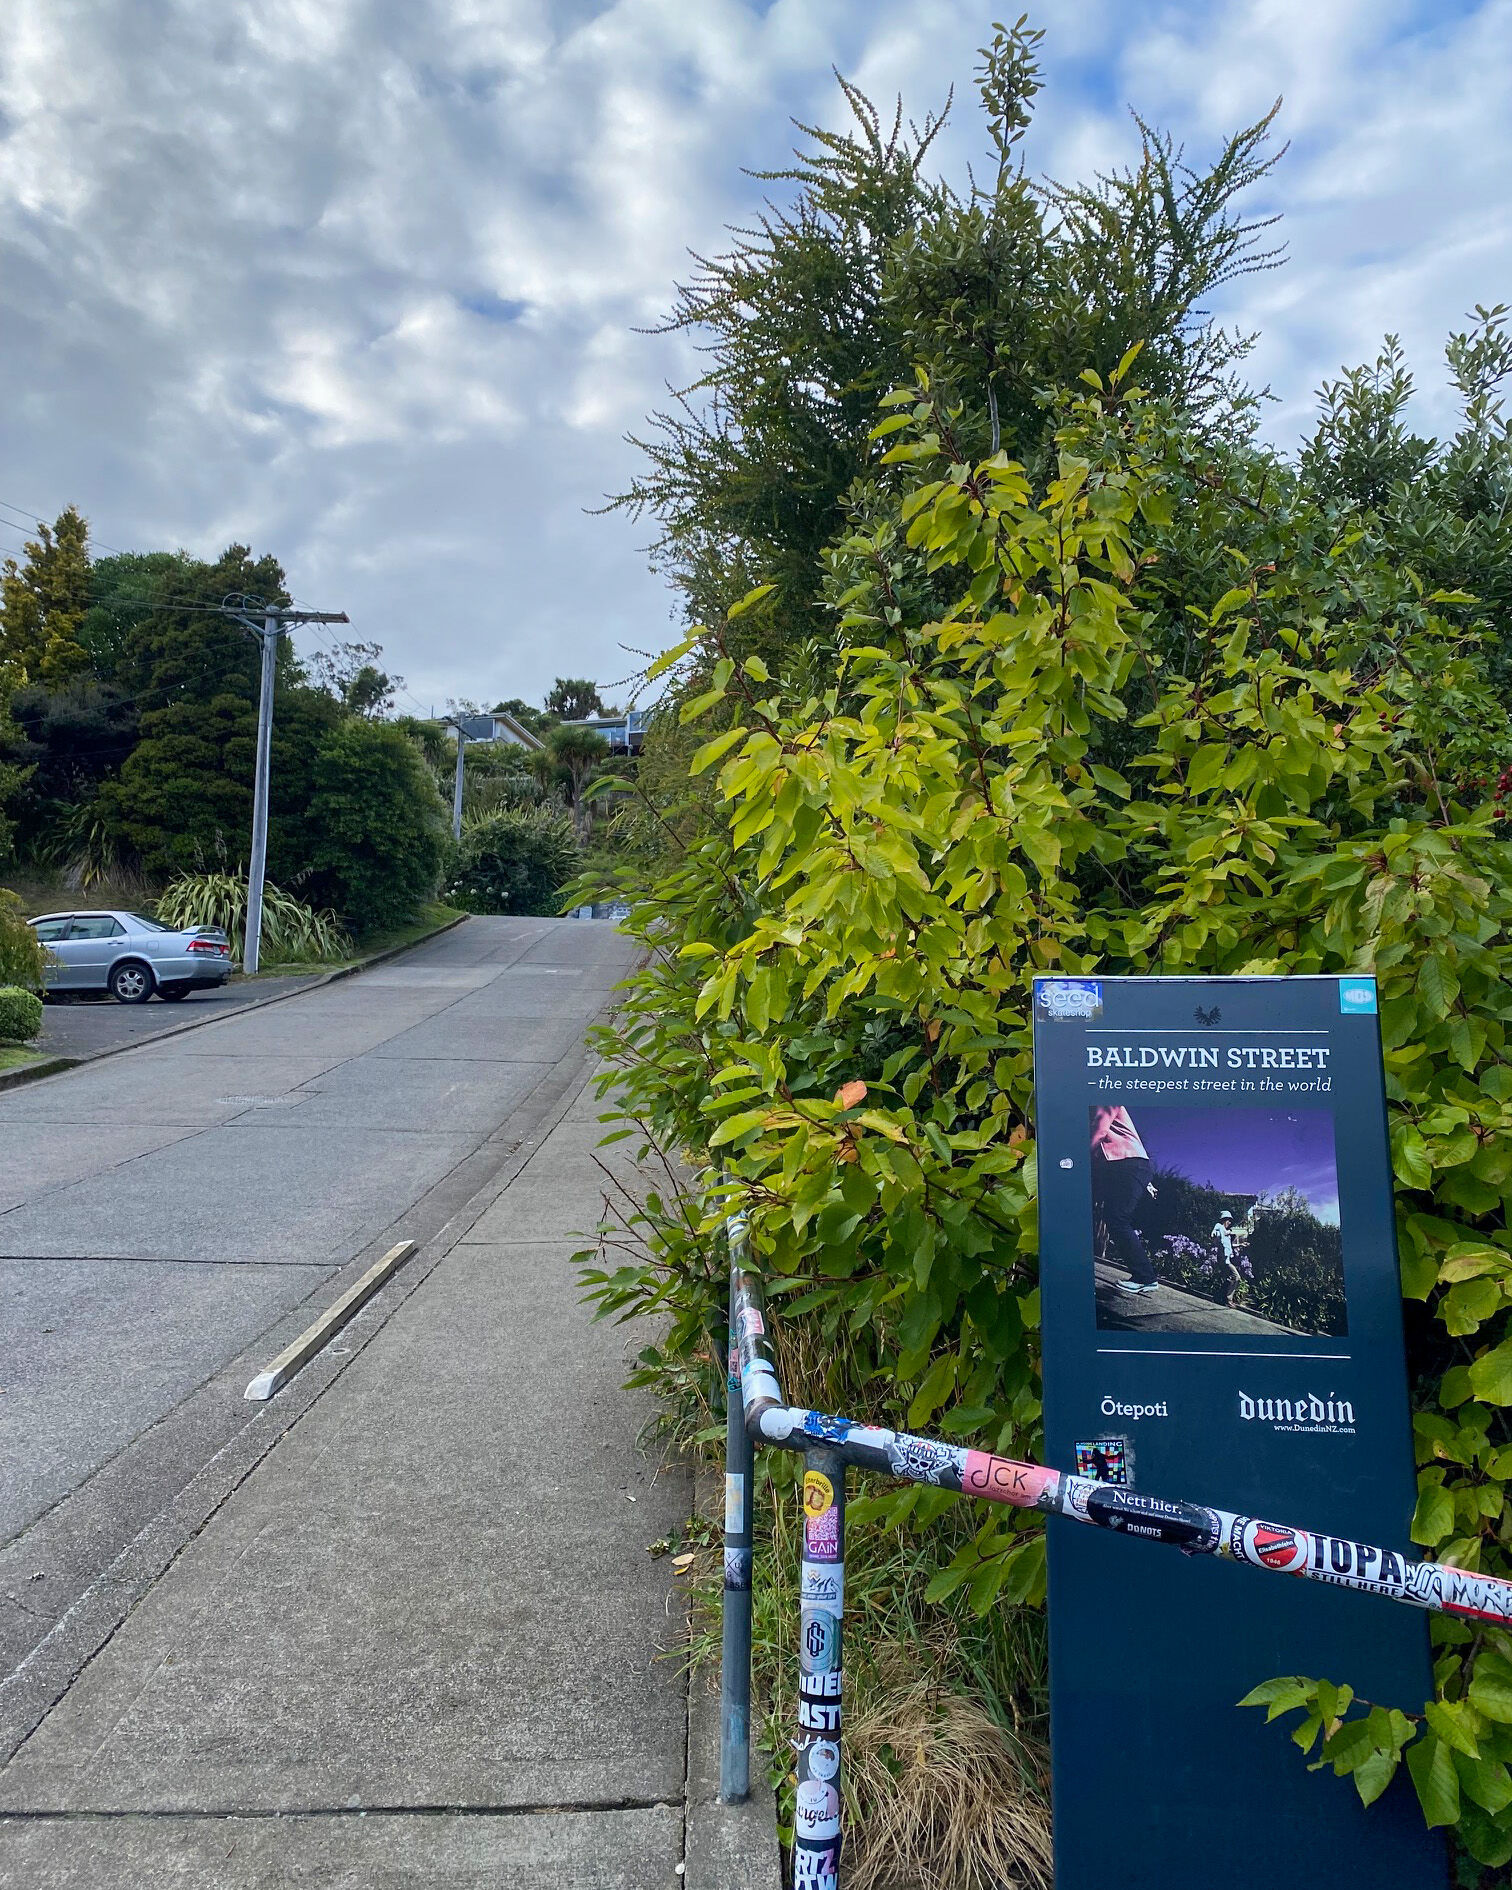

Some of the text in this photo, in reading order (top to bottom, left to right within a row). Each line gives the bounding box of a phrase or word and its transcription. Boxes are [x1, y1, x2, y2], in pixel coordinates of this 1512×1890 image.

[1040, 985, 1099, 1008] seed
[1087, 1046, 1330, 1069] BALDWIN STREET
[1126, 1077, 1189, 1093] steepest
[1192, 1078, 1237, 1091] street
[1240, 1076, 1256, 1091] in
[1260, 1076, 1284, 1092] the
[1287, 1077, 1332, 1092] world
[1100, 1395, 1168, 1420] Ōtepoti
[1273, 1424, 1356, 1434] www.DunedinNZ.com
[1112, 1490, 1147, 1508] Nett
[1149, 1497, 1182, 1515] hier.
[1127, 1523, 1162, 1538] DONOTS
[1308, 1533, 1406, 1584] TOPA
[1311, 1571, 1400, 1597] STILL HERE
